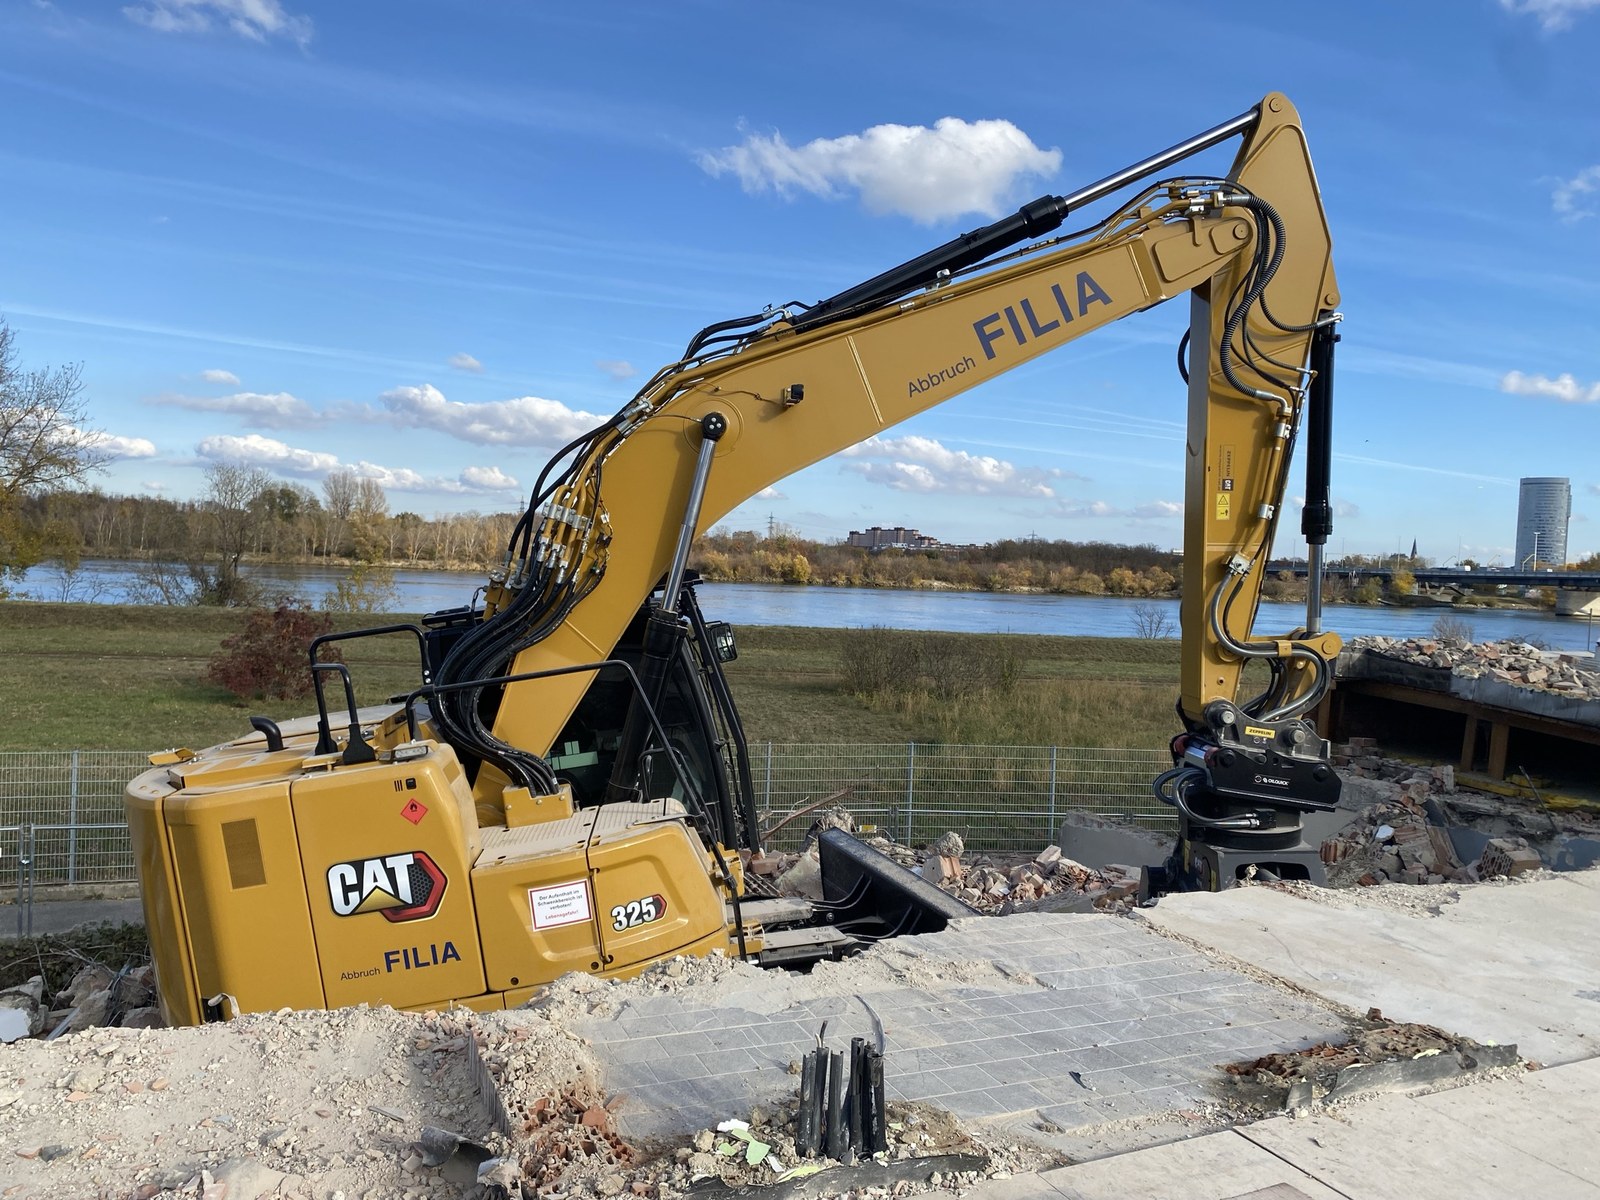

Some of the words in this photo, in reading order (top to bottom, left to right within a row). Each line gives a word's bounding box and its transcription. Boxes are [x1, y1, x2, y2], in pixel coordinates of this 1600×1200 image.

[907, 356, 976, 397] Abbruch
[972, 271, 1113, 360] FILIA
[327, 853, 414, 916] CAT
[548, 891, 573, 899] Aufenthalt
[537, 896, 576, 907] Schwenkbereich
[550, 902, 572, 910] verboten!
[545, 910, 579, 920] Lebensgefahr!
[611, 896, 656, 931] 325
[340, 967, 381, 981] Abbruch
[384, 941, 461, 973] FILIA
